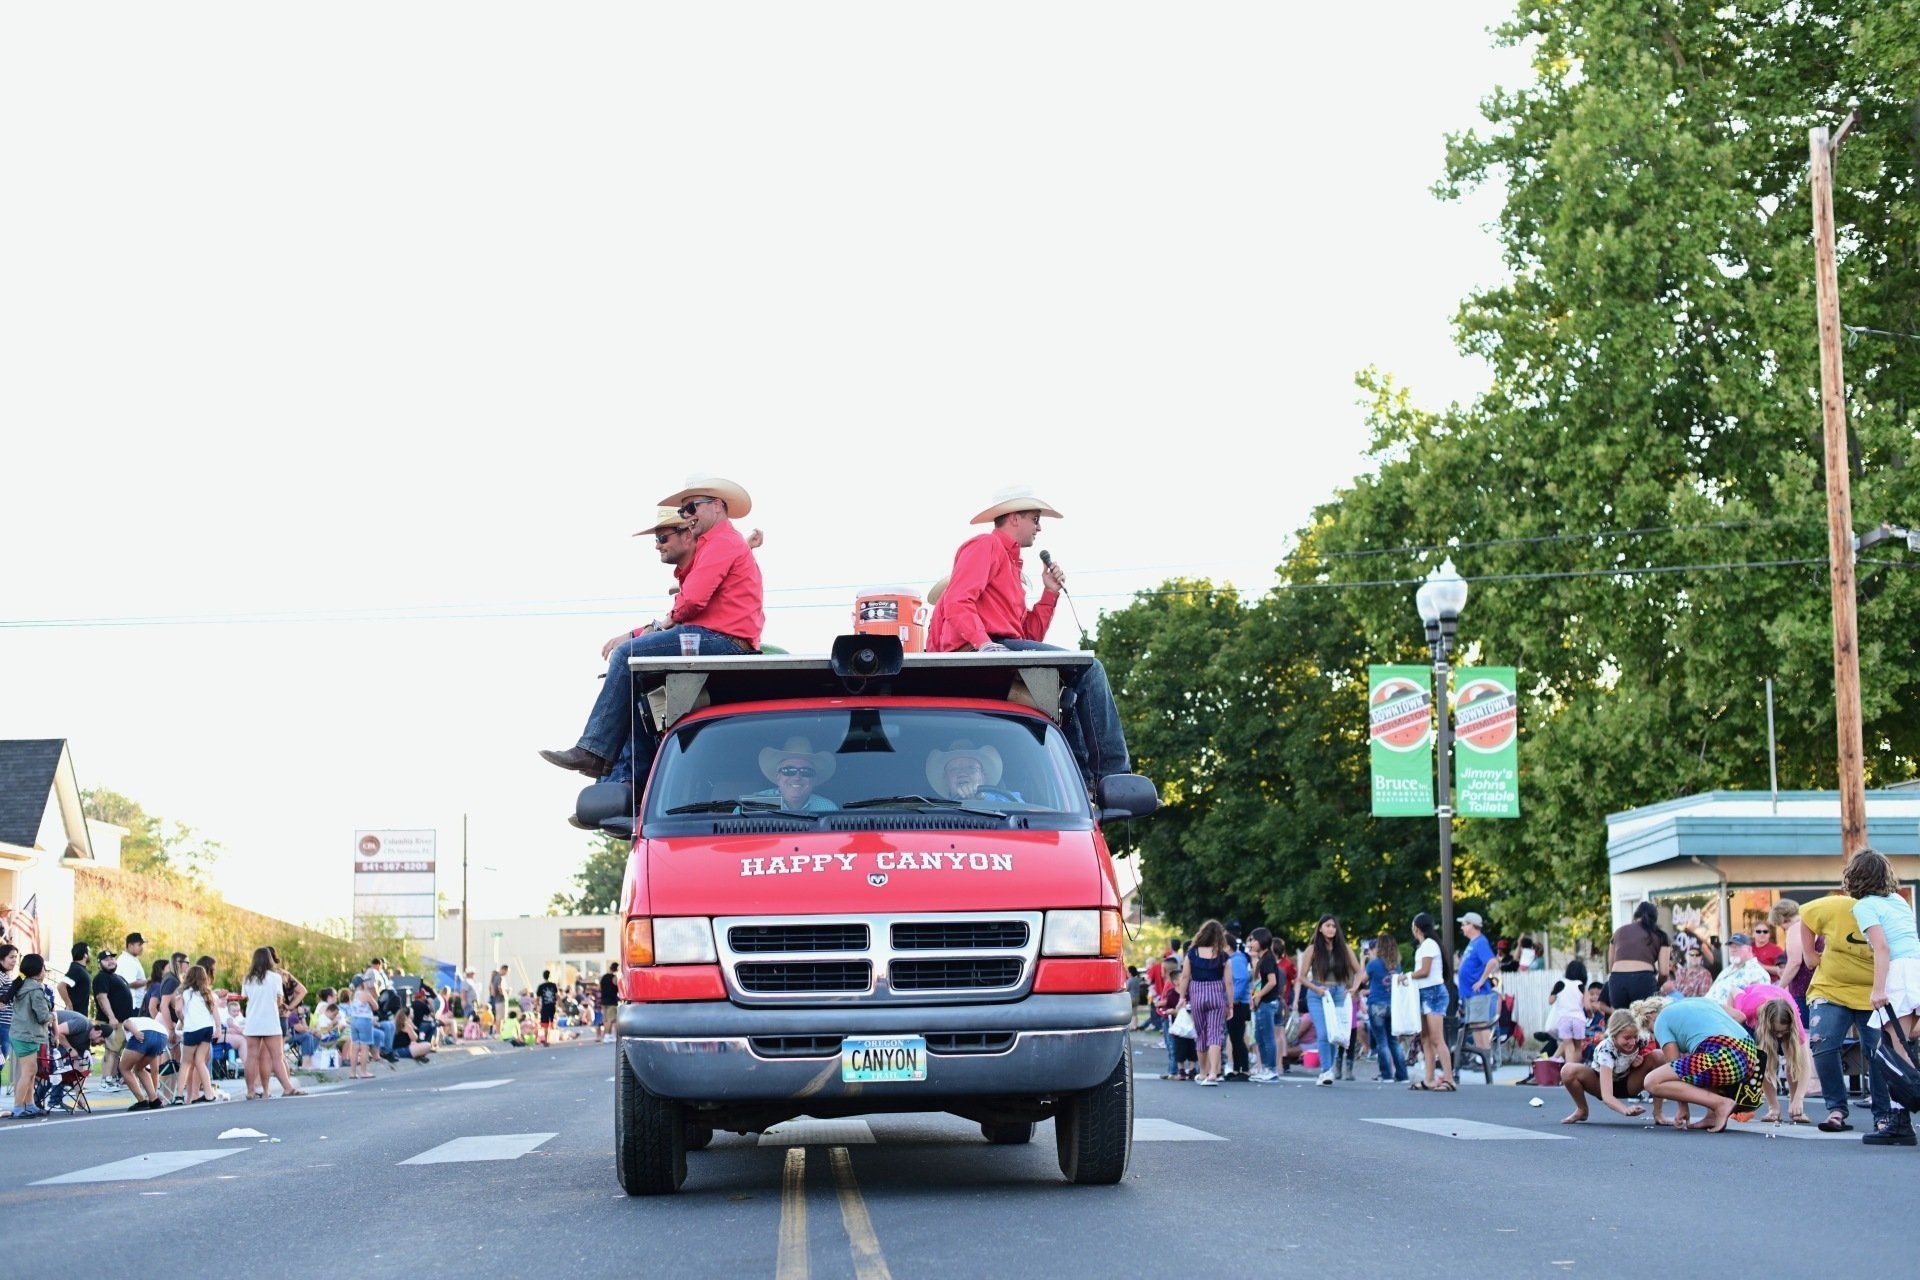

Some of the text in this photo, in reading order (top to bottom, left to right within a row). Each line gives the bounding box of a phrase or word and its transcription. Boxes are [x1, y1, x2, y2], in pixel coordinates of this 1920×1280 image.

[1372, 695, 1424, 724] DOWNTOWN
[1458, 697, 1510, 725] DOWNTOWN
[1375, 709, 1429, 734] HERMISTON
[1461, 710, 1515, 735] HERMISTON
[1375, 775, 1418, 790] Bruce
[1461, 768, 1513, 781] Jimmy's
[1468, 779, 1506, 790] Johns
[1461, 789, 1515, 802] Portable
[1469, 801, 1509, 812] Toilets
[740, 852, 1013, 876] HAPPY CANYON
[864, 1040, 904, 1048] OREGON
[852, 1048, 917, 1072] CANYON
